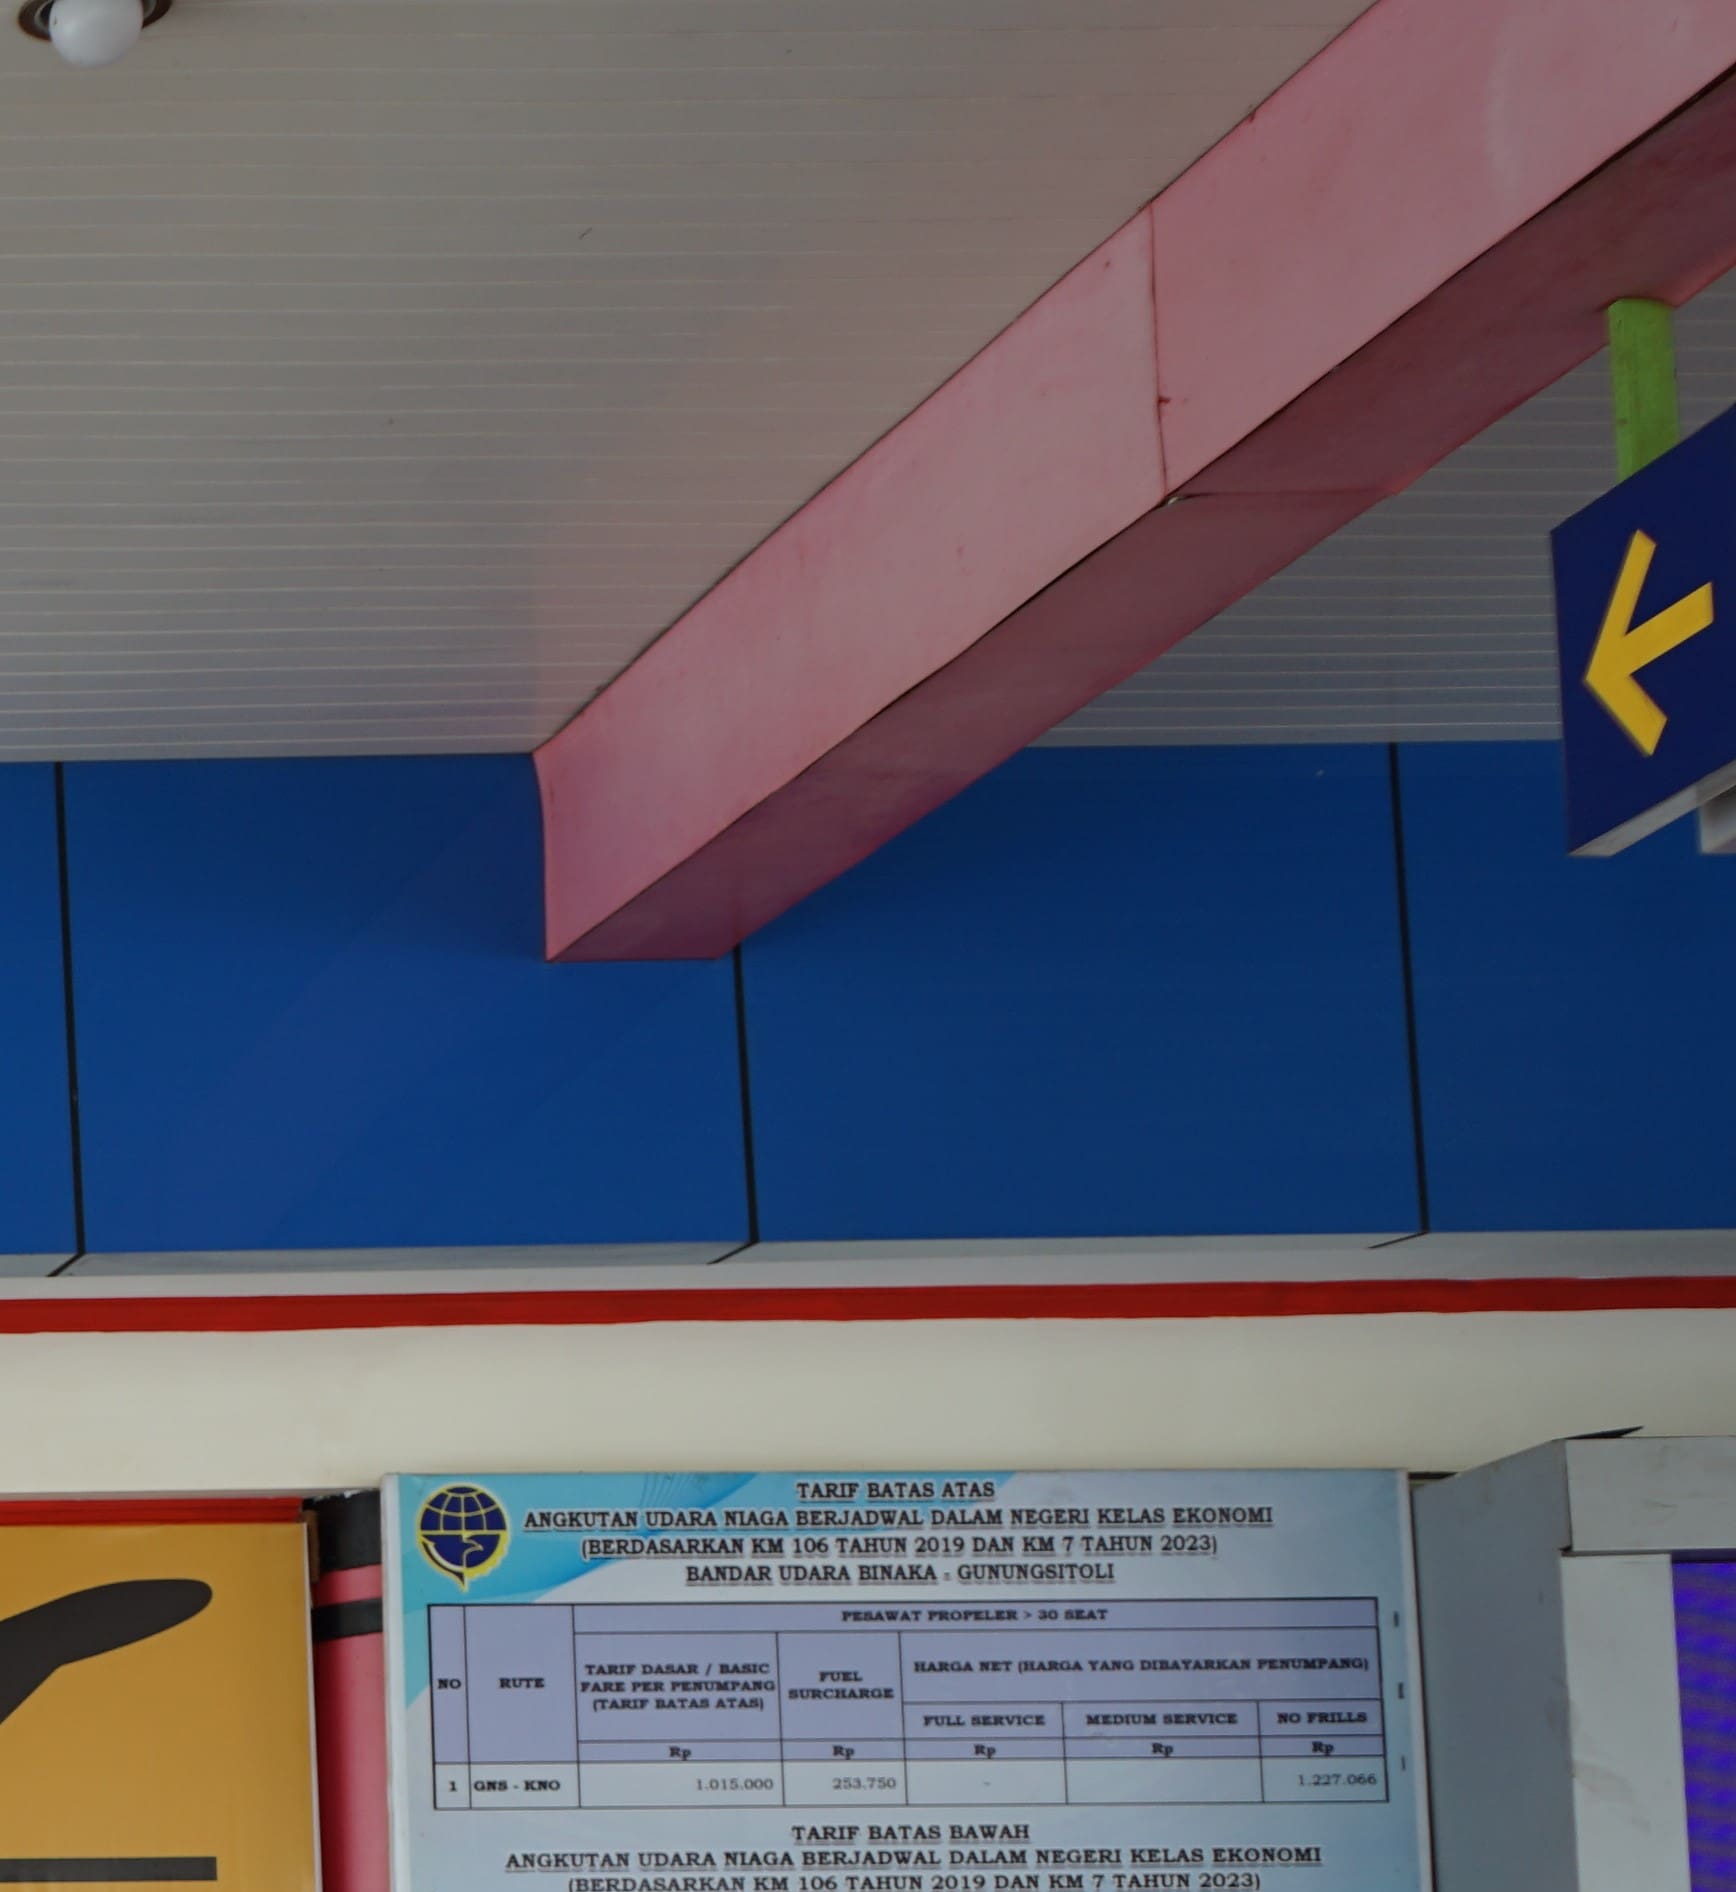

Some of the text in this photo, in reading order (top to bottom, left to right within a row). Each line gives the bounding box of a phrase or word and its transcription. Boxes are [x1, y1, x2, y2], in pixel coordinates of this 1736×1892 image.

[797, 1482, 994, 1498] TARIF BATAS ATAS
[525, 1507, 1272, 1528] ANGKUTAN UDARA NIAGA BERJADWAL DALAM NEGERI KELAS EKONOMI
[582, 1535, 1217, 1559] (BERDASARKAN KM 106 TAHUN 2019 DAN KM 7 TAHUN 2023)
[686, 1564, 1114, 1582] BANDAR UDARA BINAKA GUNUNGSITOLI
[841, 1609, 1108, 1622] PESAWAT PROPELER 30 SEAT
[914, 1658, 1369, 1674] HARGA NET (HARGA YANG DIBAYARKAN PENUMPANG)
[819, 1671, 862, 1682] FUEL
[438, 1679, 461, 1690] NO
[500, 1678, 544, 1689] RUTE
[789, 1688, 894, 1700] SURCHARGE
[474, 1780, 560, 1792] GNS KNO
[696, 1778, 773, 1791] 1.015.000
[833, 1778, 896, 1789] 253.750
[1298, 1774, 1376, 1785] 1.227.066
[792, 1824, 1029, 1840] TARIF BATAS BAWAH
[506, 1847, 1321, 1868] ANGKUTAN UDARA NIAGA BERJADWAL DALAM NEGERI KELAS EKONOMI
[753, 1877, 788, 1891] KM
[799, 1876, 837, 1891] 106
[846, 1876, 922, 1890] TAHUN
[932, 1875, 985, 1890] 2019
[994, 1875, 1039, 1889] DAN
[1049, 1875, 1083, 1889] KM
[1093, 1875, 1104, 1888] 7
[1113, 1874, 1191, 1888] TAHUN
